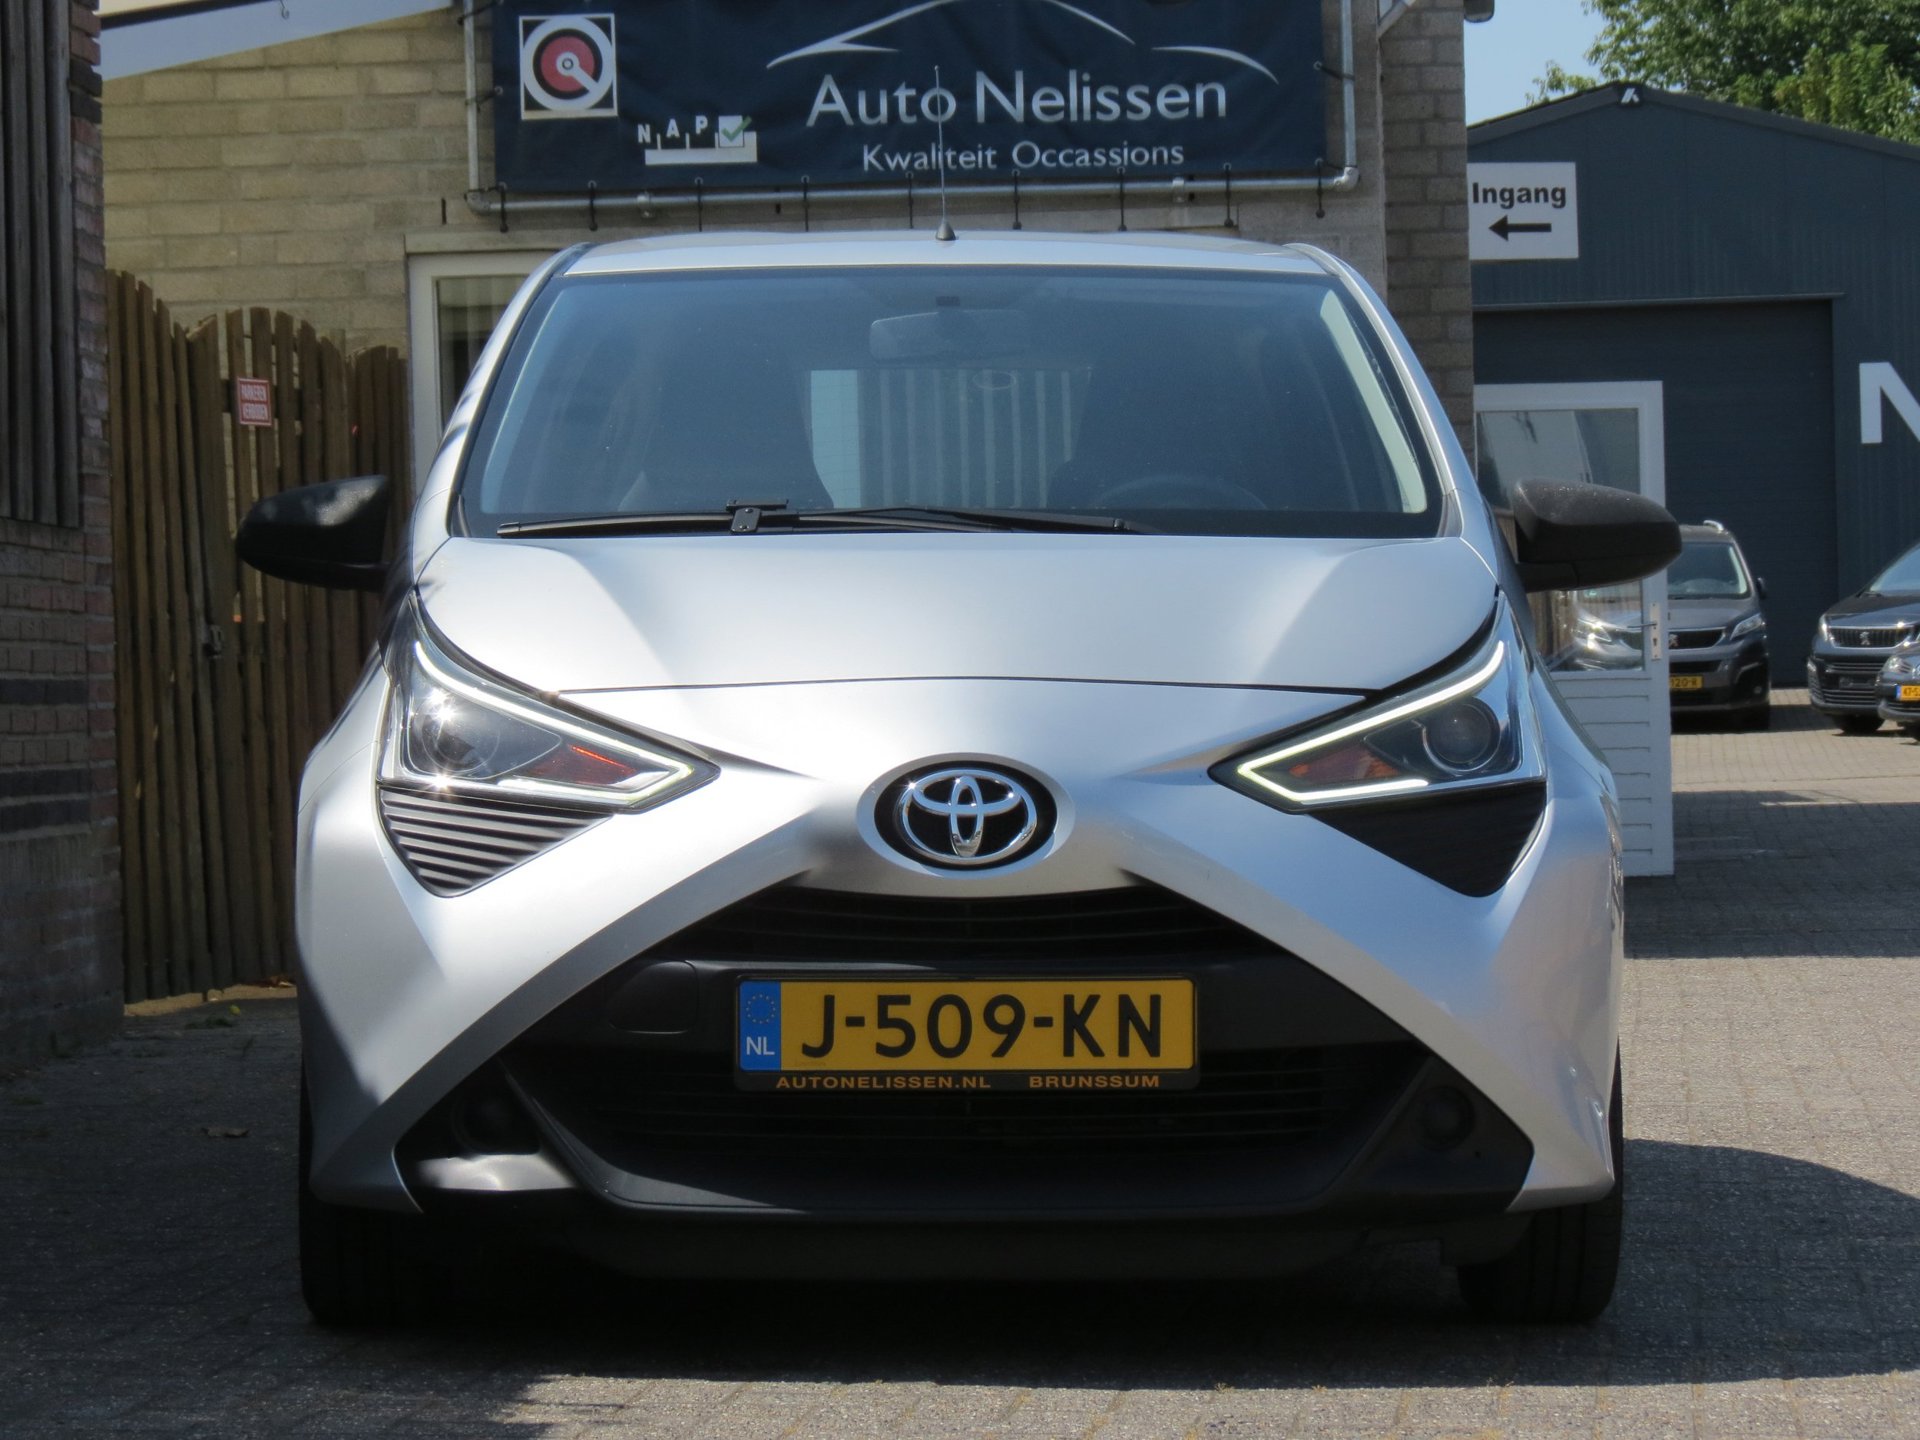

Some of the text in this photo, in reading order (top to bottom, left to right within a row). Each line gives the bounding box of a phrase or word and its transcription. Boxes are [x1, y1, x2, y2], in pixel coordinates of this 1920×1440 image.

[806, 69, 1227, 127] Auto Nelissen
[863, 140, 1184, 171] Kwaliteit Occassions
[1472, 183, 1567, 209] Ingang
[801, 993, 1162, 1059] J-509-KN
[745, 1036, 775, 1056] NL
[776, 1075, 1160, 1089] AUTONELISSEN.NL BRUNSSUM
